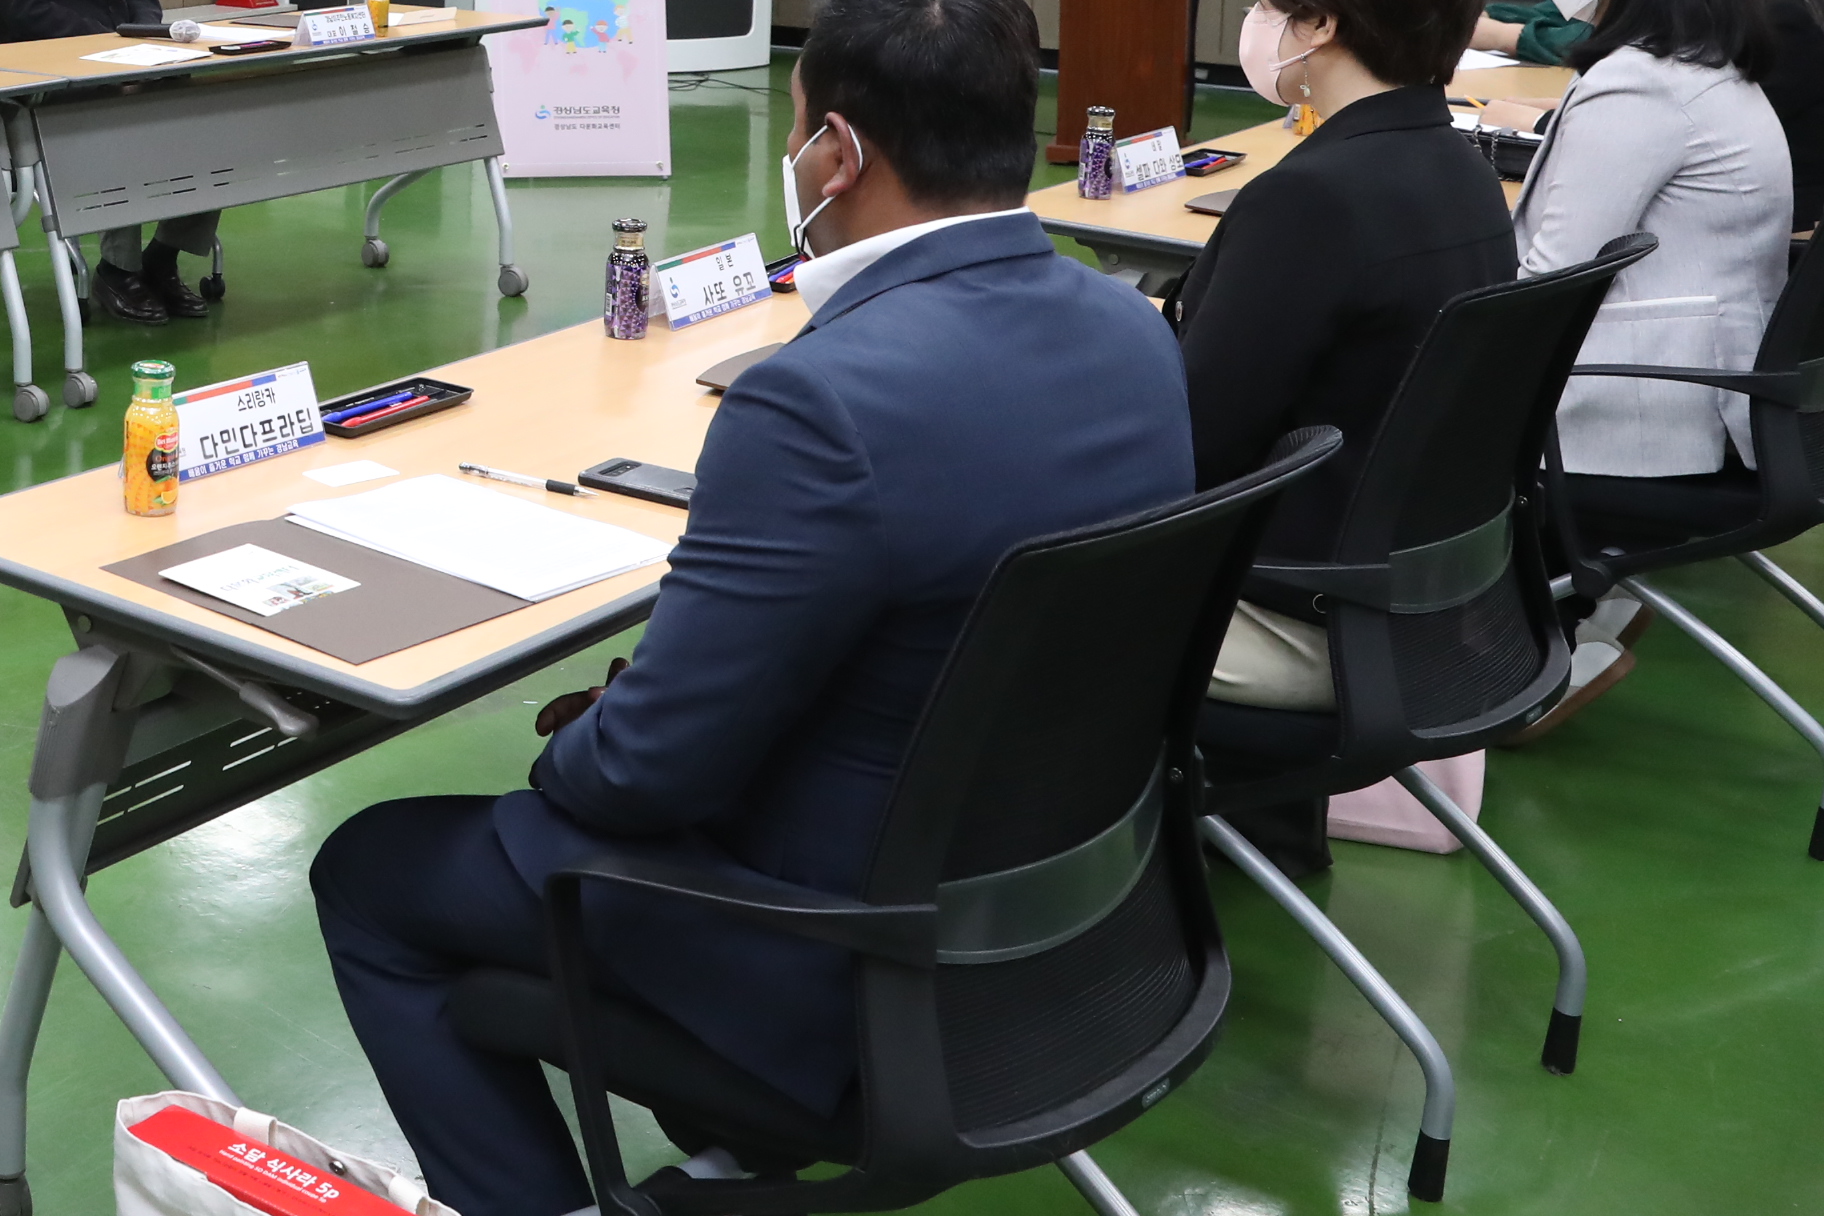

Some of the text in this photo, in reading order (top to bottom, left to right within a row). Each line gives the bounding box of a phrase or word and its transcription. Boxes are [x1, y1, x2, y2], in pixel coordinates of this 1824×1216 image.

[553, 105, 621, 115] 경상남도교육청
[703, 281, 727, 306] 사또
[237, 386, 276, 412] 스리랑카
[199, 407, 314, 460] 다민다프라딥
[227, 1142, 267, 1164] 소담
[266, 1157, 318, 1188] 식사라
[315, 1181, 340, 1200] 5p
